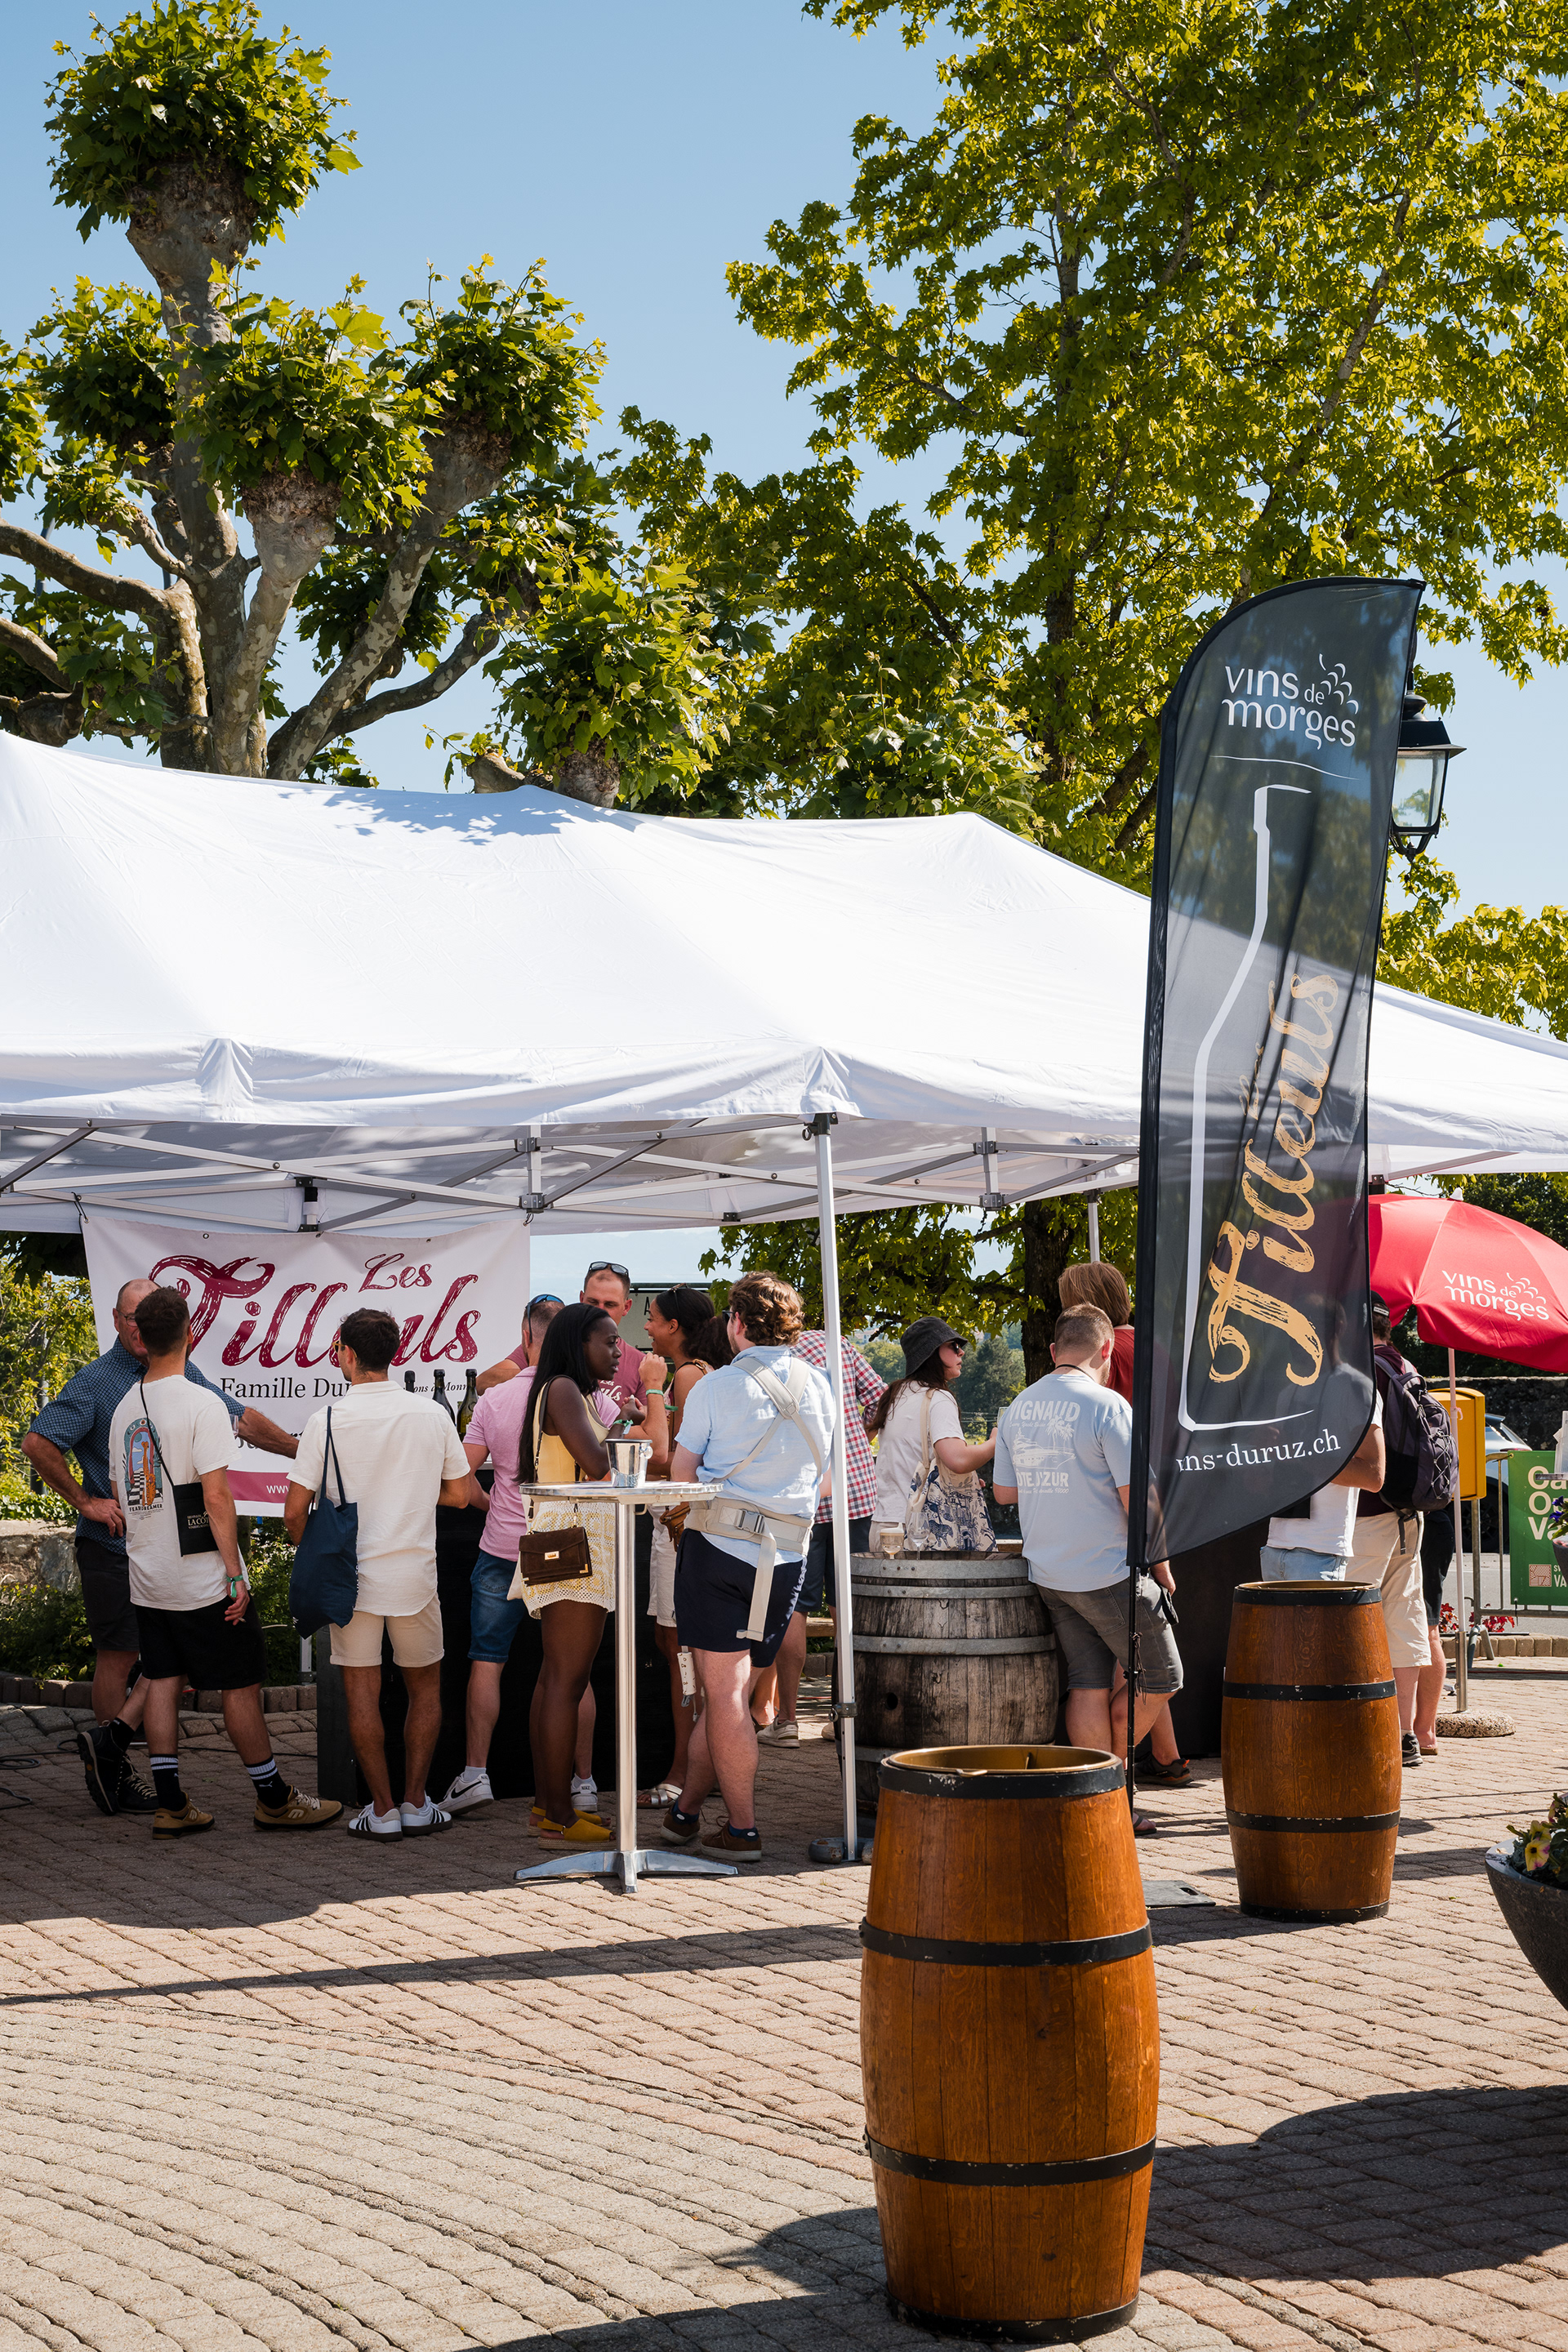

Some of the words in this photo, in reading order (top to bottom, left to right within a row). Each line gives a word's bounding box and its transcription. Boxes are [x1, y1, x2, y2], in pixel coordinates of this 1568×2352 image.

[1225, 666, 1299, 700] vins
[1303, 683, 1325, 706] de
[1221, 698, 1356, 751] morges
[358, 1252, 433, 1293] Les
[1441, 1270, 1497, 1294] vins
[1499, 1286, 1517, 1298] de
[148, 1254, 482, 1369] Tilluls
[1444, 1285, 1549, 1321] morges
[220, 1377, 306, 1399] Famille
[1009, 1400, 1081, 1423] VIGNAUD
[196, 1516, 209, 1526] CÔT
